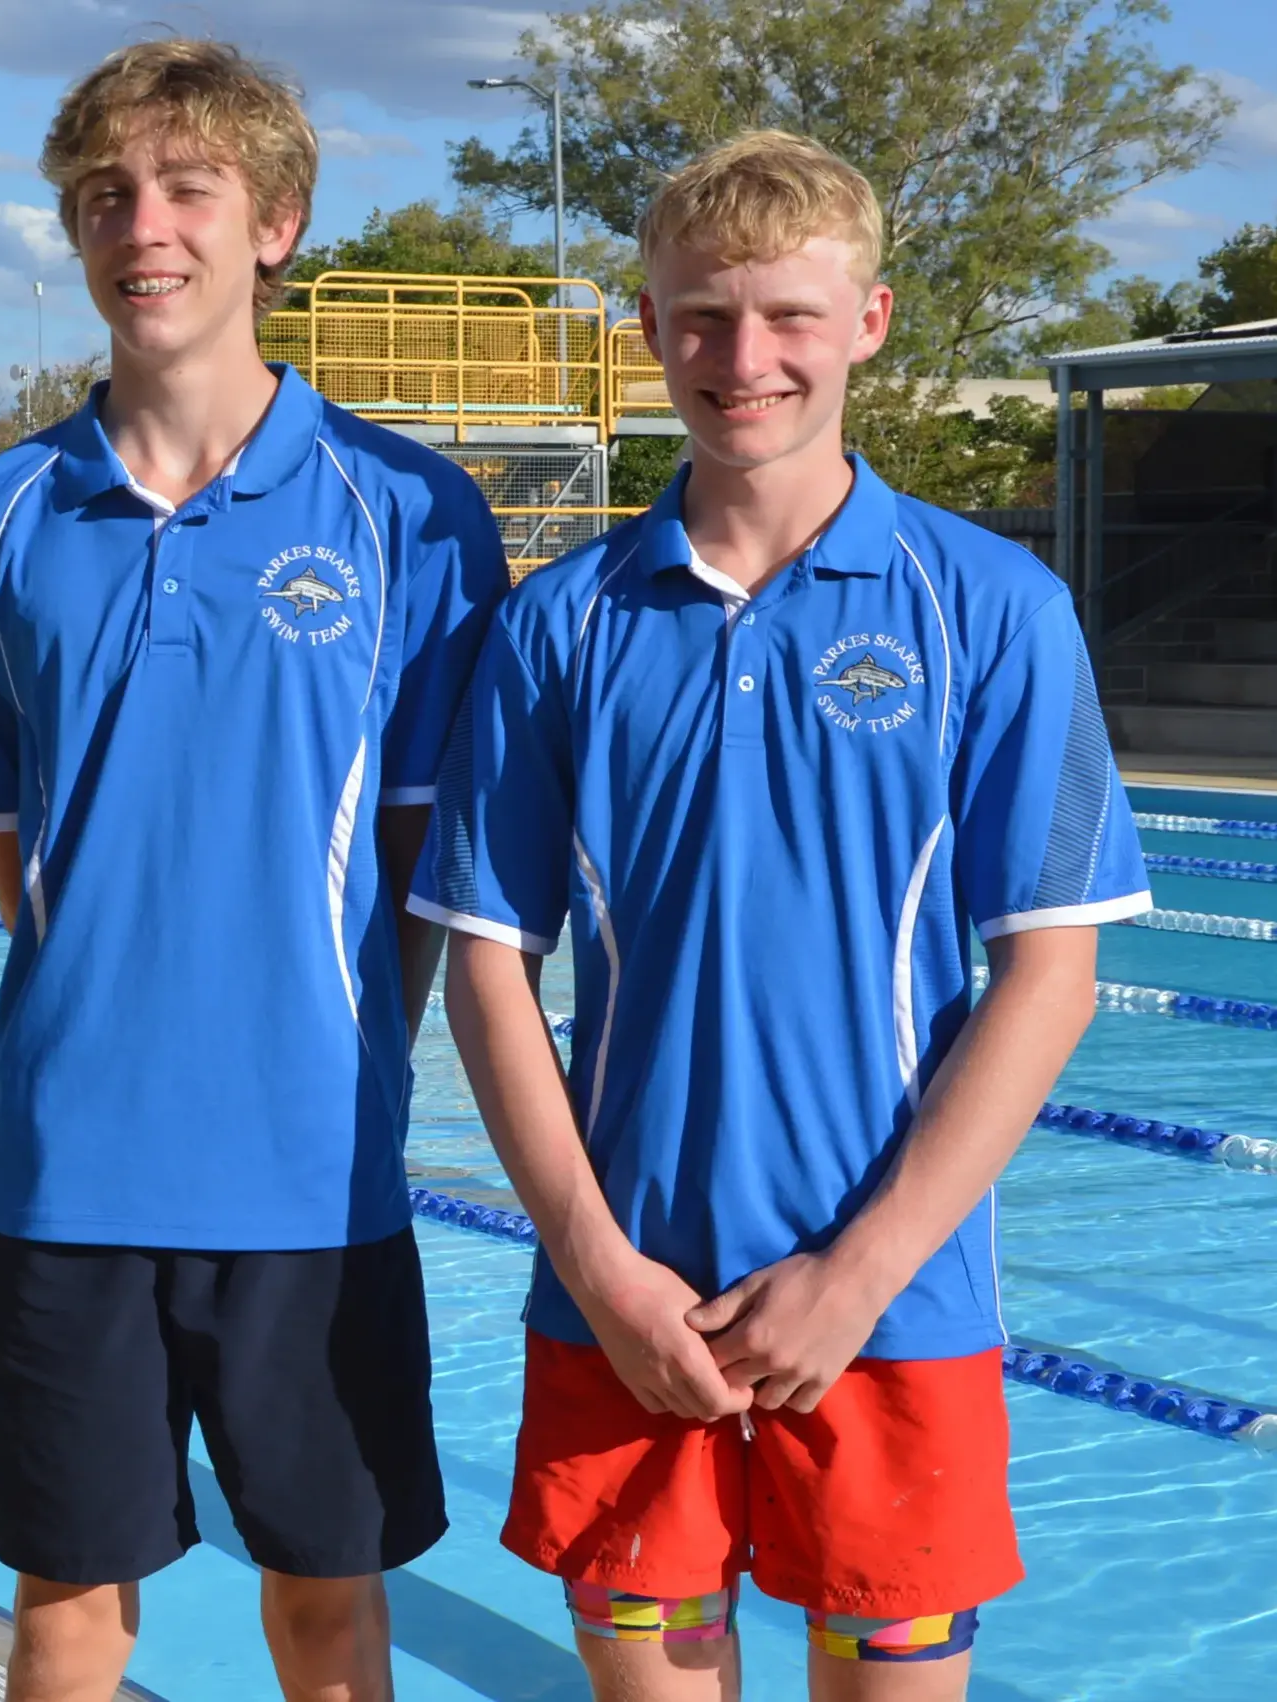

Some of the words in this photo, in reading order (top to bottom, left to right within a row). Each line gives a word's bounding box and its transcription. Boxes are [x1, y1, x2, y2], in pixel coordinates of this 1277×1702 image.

[257, 545, 312, 588] PARKES
[315, 546, 361, 598] SHARKS
[262, 606, 301, 643] SWIM
[308, 614, 353, 646] TEAM
[812, 633, 870, 676] PARKES
[874, 633, 925, 684] SHARKS
[817, 695, 862, 732] SWIM
[867, 701, 917, 733] TEAM
